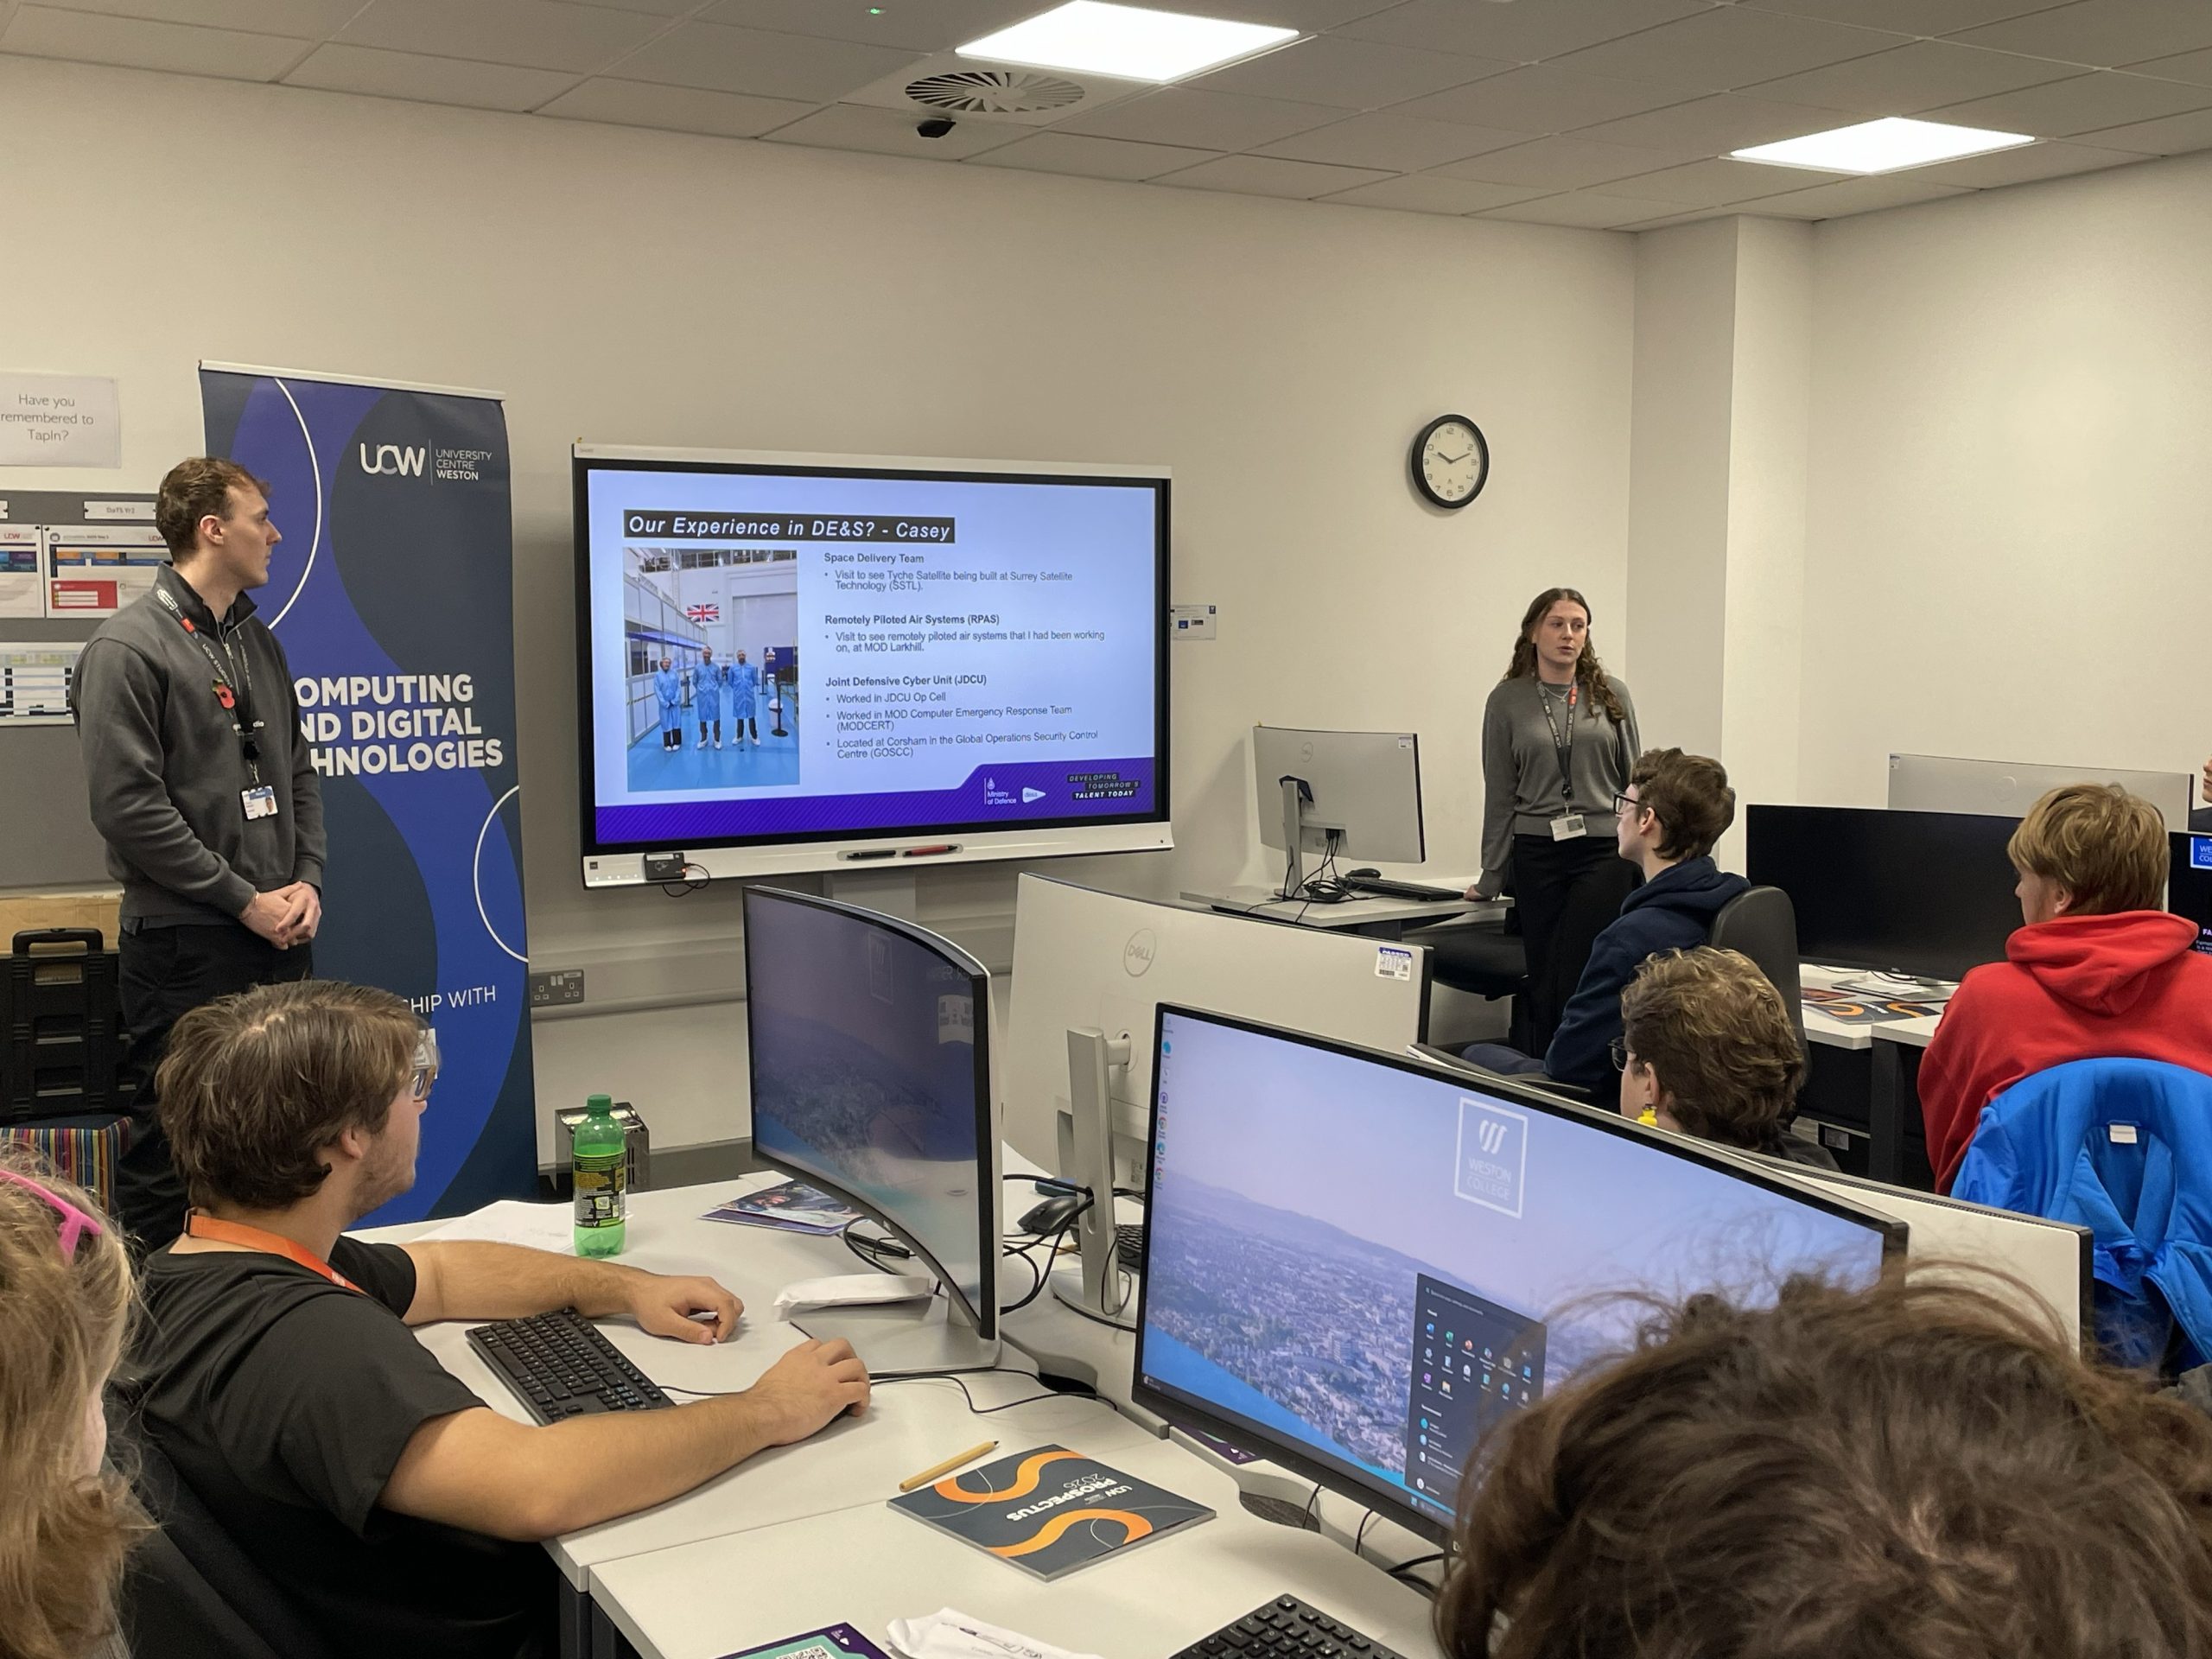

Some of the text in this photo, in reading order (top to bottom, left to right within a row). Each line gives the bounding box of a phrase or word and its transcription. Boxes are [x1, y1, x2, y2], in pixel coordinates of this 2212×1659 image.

[18, 394, 75, 410] Have you
[0, 413, 94, 425] remembered to
[359, 442, 426, 477] UCW
[435, 448, 492, 461] UNIVERSITY
[435, 459, 475, 470] CENTRE
[436, 469, 479, 480] WESTON
[629, 516, 665, 533] Our
[673, 518, 779, 537] Experience
[788, 519, 804, 536] in
[811, 520, 874, 537] DE&S?
[896, 522, 950, 541] Casey
[824, 553, 925, 565] Space Delivery Team
[836, 570, 855, 580] Visit
[857, 570, 866, 580] to
[887, 570, 914, 582] Tyche
[917, 571, 950, 581] Satellite
[953, 571, 977, 582] being
[980, 571, 997, 581] built
[1000, 572, 1008, 581] at
[1010, 572, 1038, 582] Surrey
[1040, 572, 1072, 582] Satellite
[836, 580, 923, 591] Technology (SSTL).
[825, 614, 1000, 626] Remotely Piloted Air Systems (RPAS)
[836, 632, 855, 641] Visit
[857, 632, 866, 641] to
[888, 632, 925, 643] remotely
[928, 631, 957, 642] piloted
[959, 632, 970, 640] air
[972, 632, 1007, 642] systems
[1010, 631, 1026, 640] that
[1033, 631, 1049, 639] had
[1051, 631, 1071, 639] been
[1073, 630, 1105, 641] working
[202, 643, 215, 659] UCW
[836, 645, 850, 653] on,
[864, 643, 887, 652] MOD
[890, 642, 925, 652] Larkhill.
[825, 675, 987, 688] Joint Defensive Cyber Unit (JDCU)
[294, 674, 474, 707] OMPUTING
[836, 691, 946, 704] Worked in JDCU Op Cell
[836, 705, 1072, 721] Worked in MOD Computer Emergency Response Team
[301, 707, 482, 742] ND DIGITAL
[836, 721, 894, 733] (MODCERT)
[837, 729, 1098, 748] Located at Corsham in the Global Operations Security Control
[310, 739, 503, 776] HNOLOGIES
[837, 747, 913, 760] Centre (GOSCC)
[1069, 773, 1117, 782] DEVELOPING
[1128, 944, 1150, 960] DELL
[403, 985, 496, 1014] HIP WITH
[1468, 1156, 1511, 1183] WESTON
[1466, 1175, 1510, 1201] COLLEGE
[1063, 1473, 1105, 1489] 2026
[1007, 1478, 1118, 1522] PROSPECTUS
